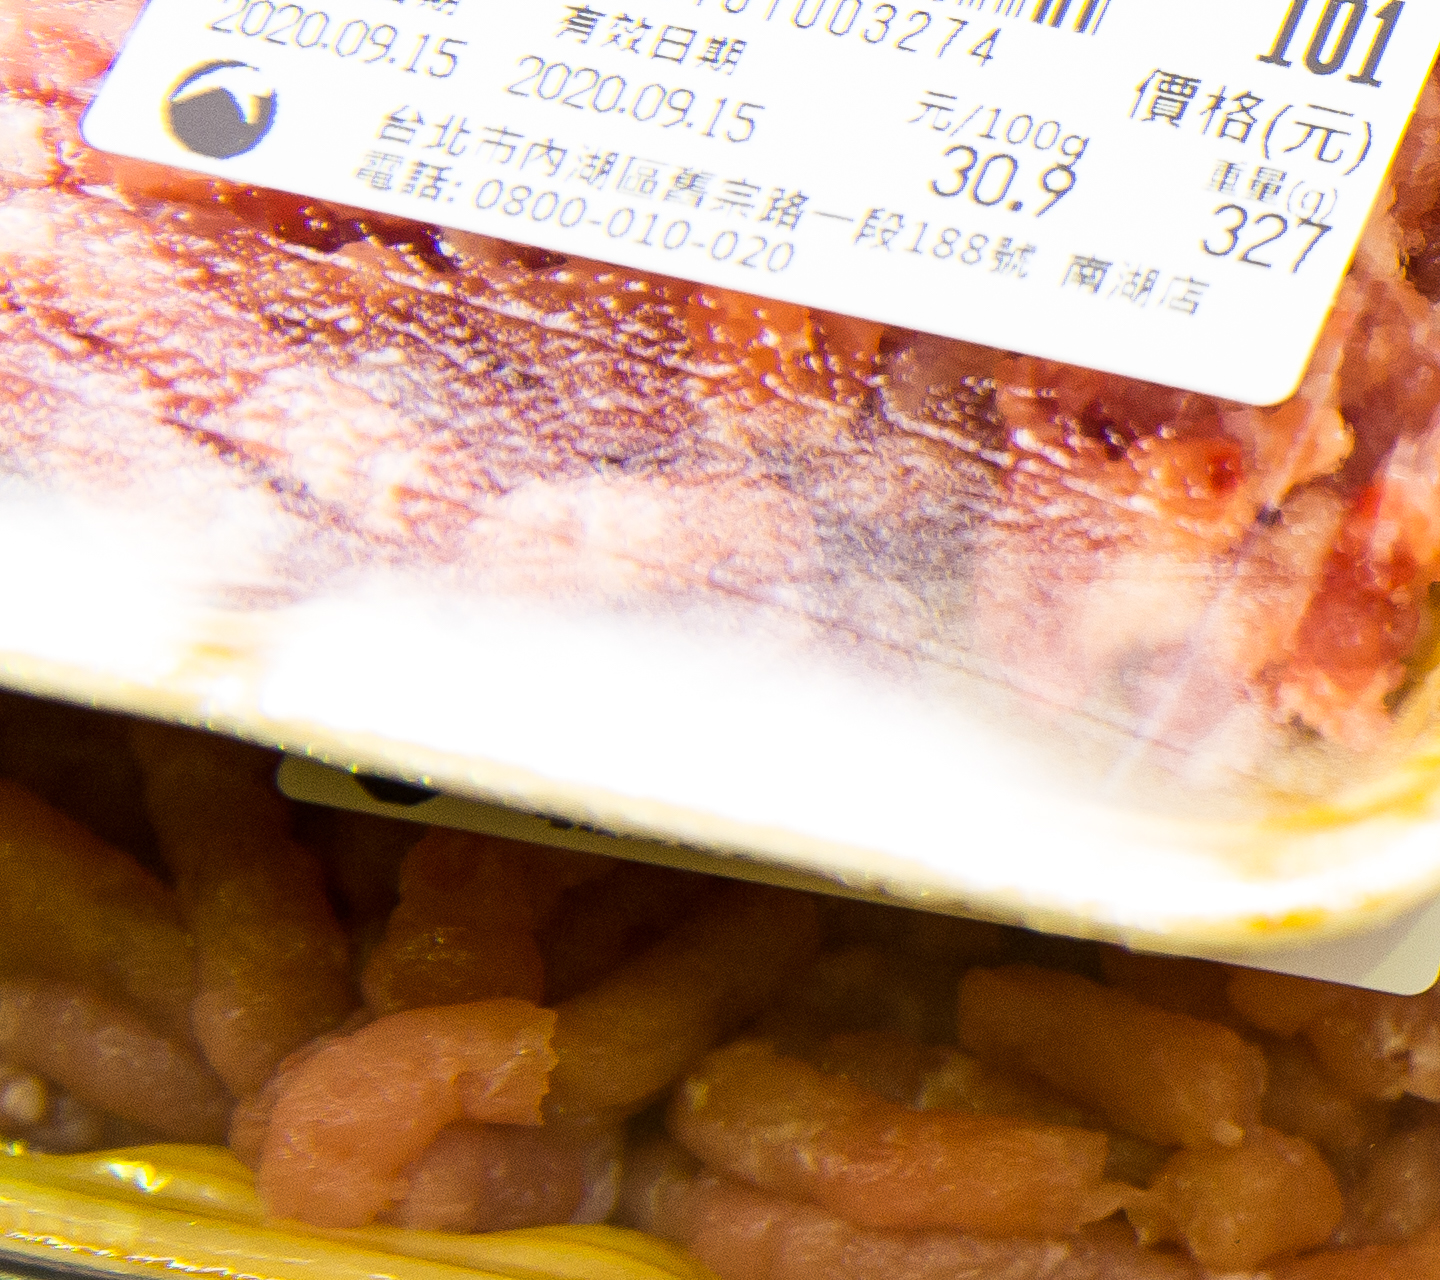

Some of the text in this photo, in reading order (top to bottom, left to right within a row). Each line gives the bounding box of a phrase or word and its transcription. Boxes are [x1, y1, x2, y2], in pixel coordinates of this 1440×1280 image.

[554, 3, 748, 76] 有效日期
[504, 54, 766, 143] 2020.09.15
[907, 90, 1090, 168] 元/100g
[1128, 66, 1375, 177] 價格(元)
[353, 149, 797, 275] 電話: 0800-010-020
[930, 143, 1079, 219] 30.9
[1206, 157, 1339, 220] 重量(g)
[1200, 203, 1333, 275] 327
[1060, 251, 1213, 318] 南湖店
